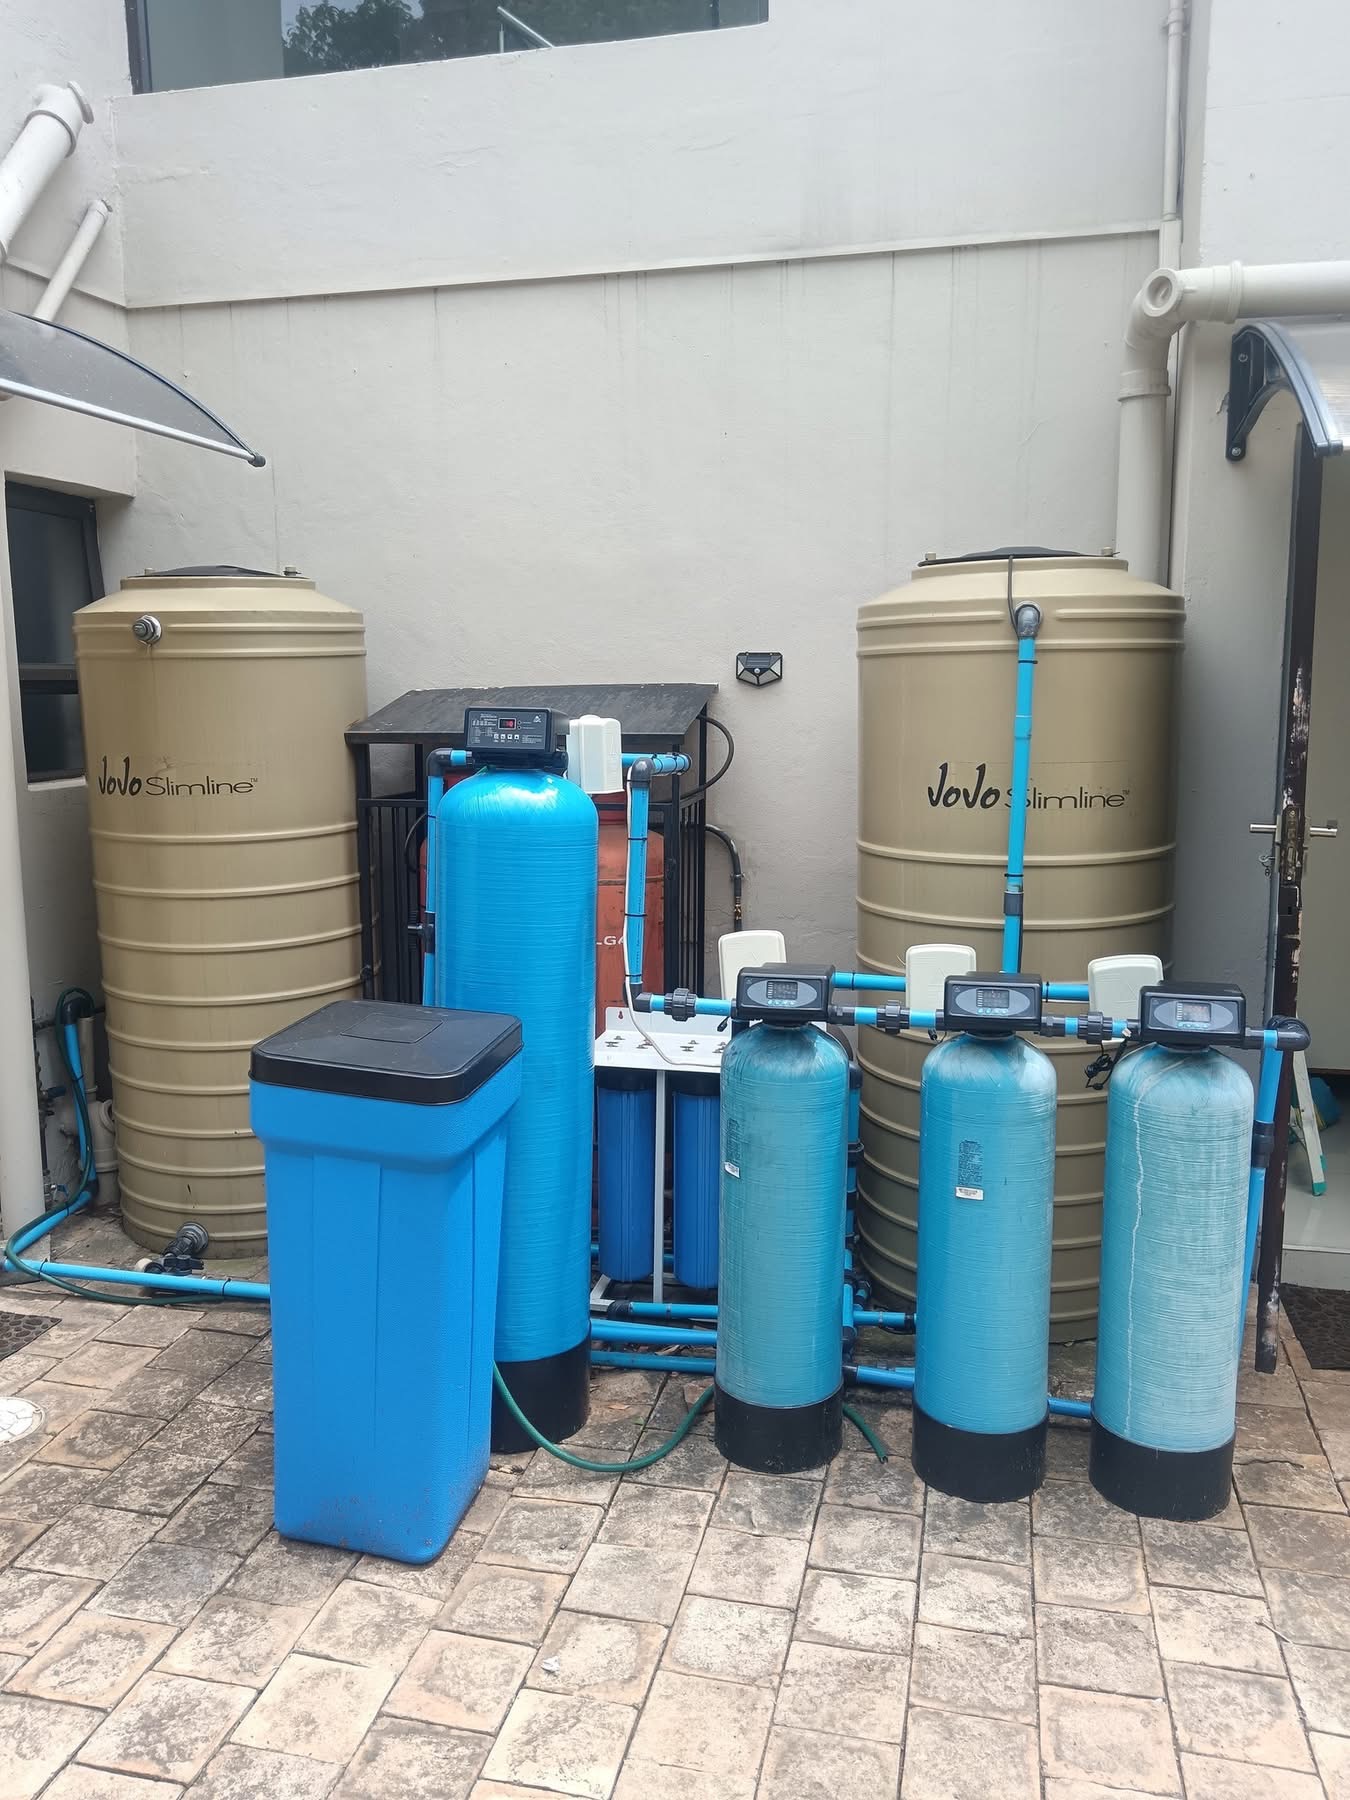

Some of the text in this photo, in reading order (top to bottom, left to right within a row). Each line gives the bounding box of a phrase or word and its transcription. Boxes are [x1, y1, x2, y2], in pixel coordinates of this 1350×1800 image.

[98, 755, 142, 796] JoJo
[145, 775, 253, 796] Slimline
[928, 762, 1000, 809] JoJo
